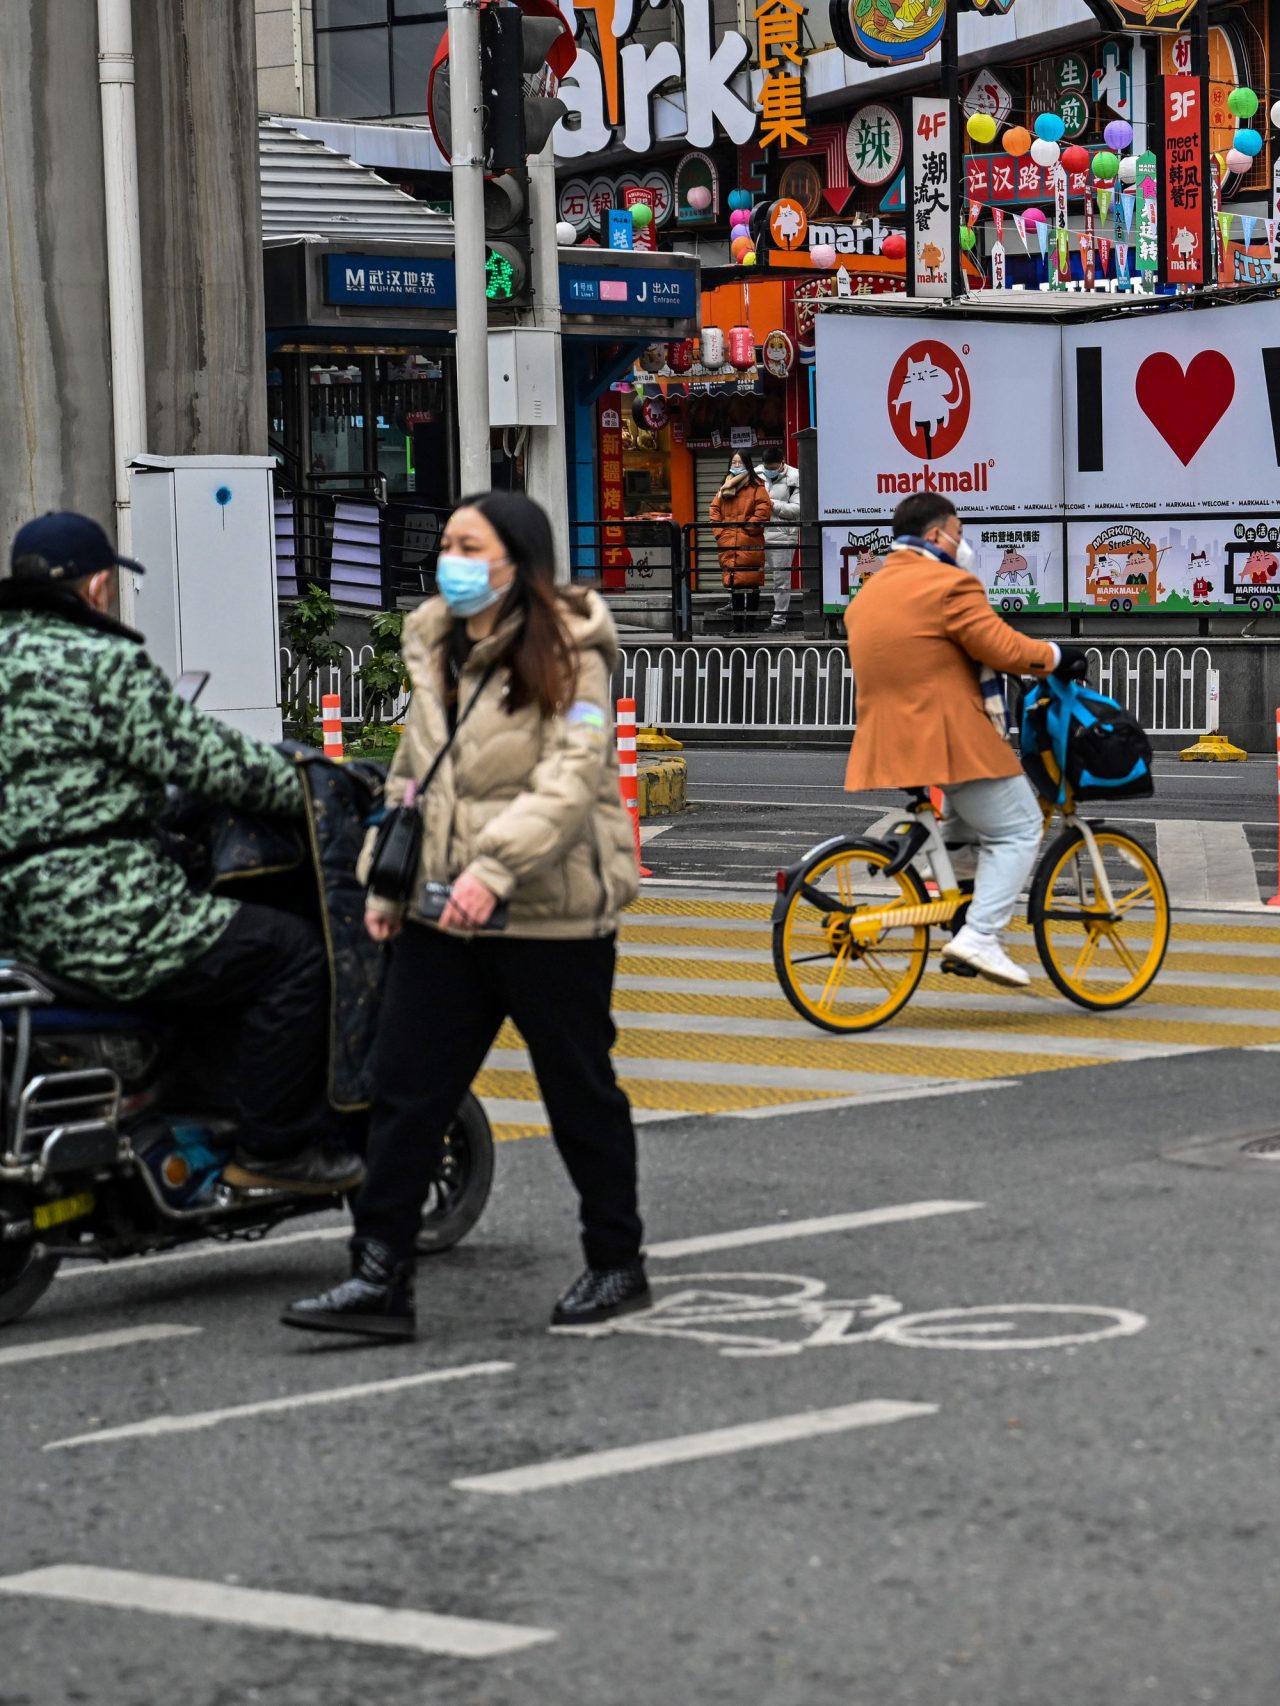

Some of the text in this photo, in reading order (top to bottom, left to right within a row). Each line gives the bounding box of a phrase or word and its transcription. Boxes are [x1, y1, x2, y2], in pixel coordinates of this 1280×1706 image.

[753, 0, 809, 149] 食集
[1061, 59, 1081, 129] 生煎
[1170, 90, 1195, 122] 3F
[917, 112, 946, 141] 4F
[855, 117, 892, 171] 辣
[1167, 133, 1199, 149] meet
[1171, 149, 1194, 163] sun
[968, 163, 1114, 193] 江汉路
[564, 187, 668, 217] 石锅
[1057, 178, 1067, 229] 红包多
[1171, 257, 1197, 270] mark
[369, 270, 435, 287] 武汉地铁
[917, 271, 944, 284] mark
[369, 285, 403, 293] WUHAN
[636, 281, 647, 302] J
[652, 282, 680, 294] 出入口
[653, 295, 680, 304] Entrance
[877, 462, 988, 494] markmall
[1059, 502, 1085, 510] WELCOME
[981, 530, 1040, 544] 城市营地风情街
[1092, 525, 1151, 550] MARK MALL
[1108, 536, 1135, 550] Street
[1097, 586, 1139, 594] MARKMALL
[1235, 586, 1280, 594] MARKMALL
